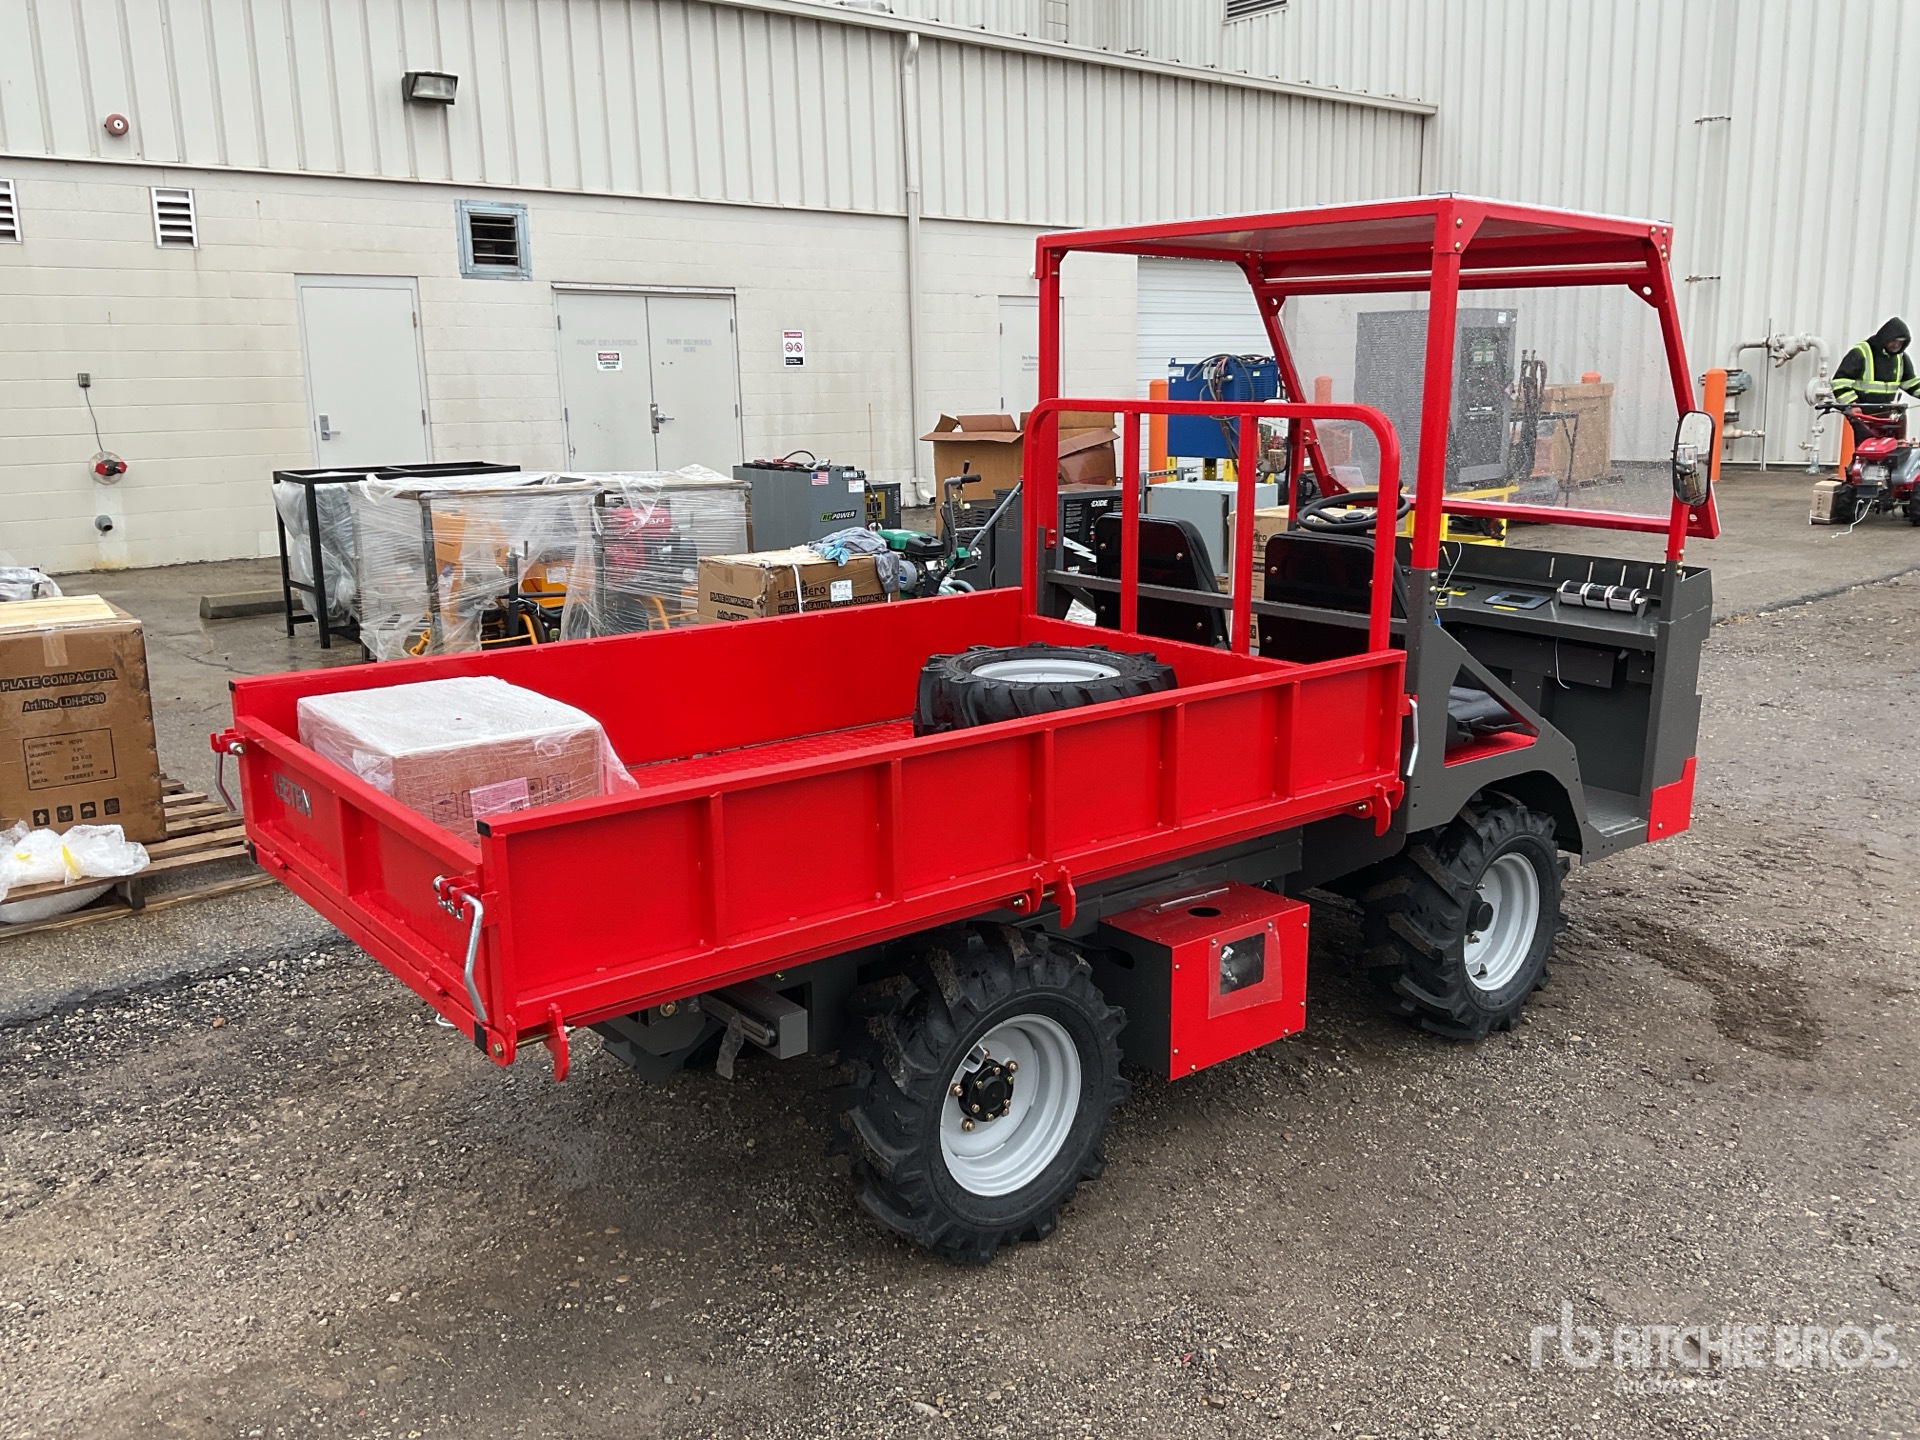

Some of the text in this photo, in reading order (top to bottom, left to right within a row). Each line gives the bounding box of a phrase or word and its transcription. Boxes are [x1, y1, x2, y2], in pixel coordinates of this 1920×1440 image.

[1, 669, 115, 690] PLATE COMPACTOR
[59, 693, 105, 707] LDH-PC90
